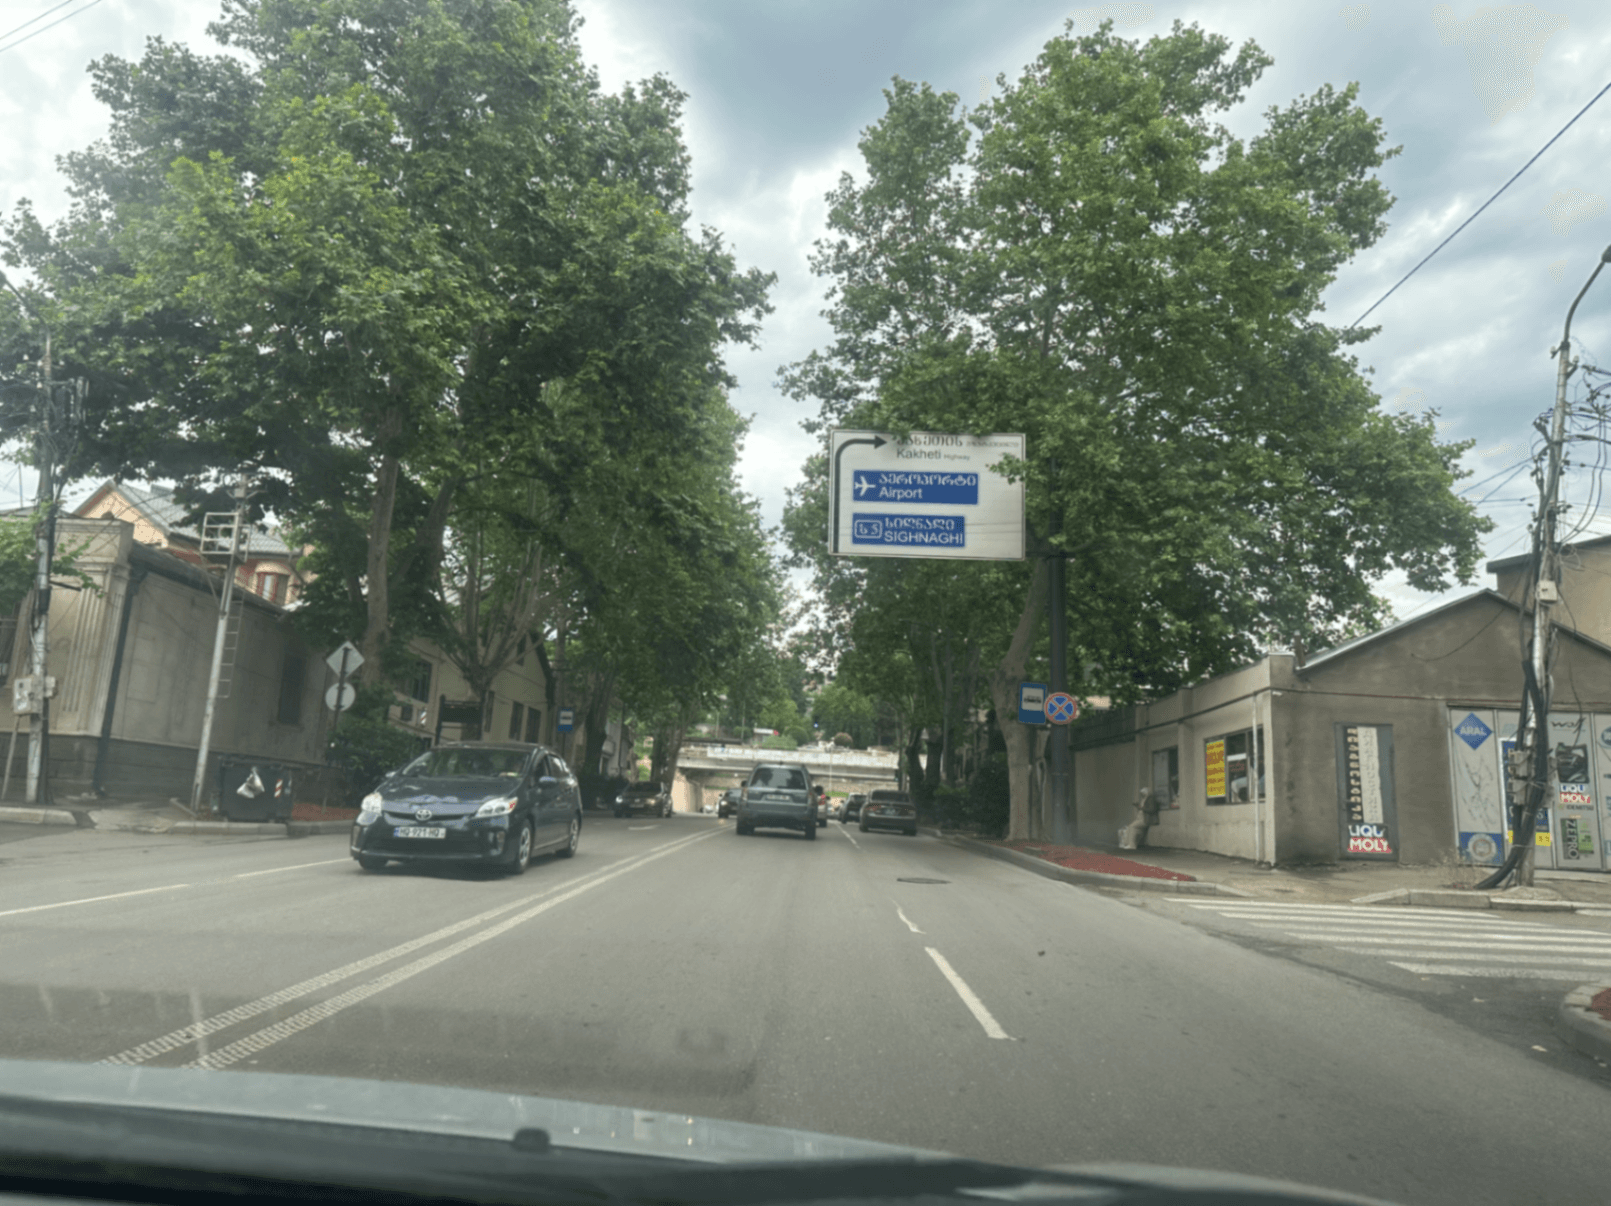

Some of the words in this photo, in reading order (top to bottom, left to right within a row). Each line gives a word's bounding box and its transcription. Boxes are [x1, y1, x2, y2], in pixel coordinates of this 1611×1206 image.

[896, 448, 941, 459] Kakheti
[879, 473, 976, 486] აეროპორტი
[879, 487, 923, 500] Airport
[884, 531, 963, 544] SIGHNAGHI
[1560, 793, 1591, 804] MOLY
[1349, 838, 1388, 852] MOLY
[1566, 819, 1579, 859] ZEPRO
